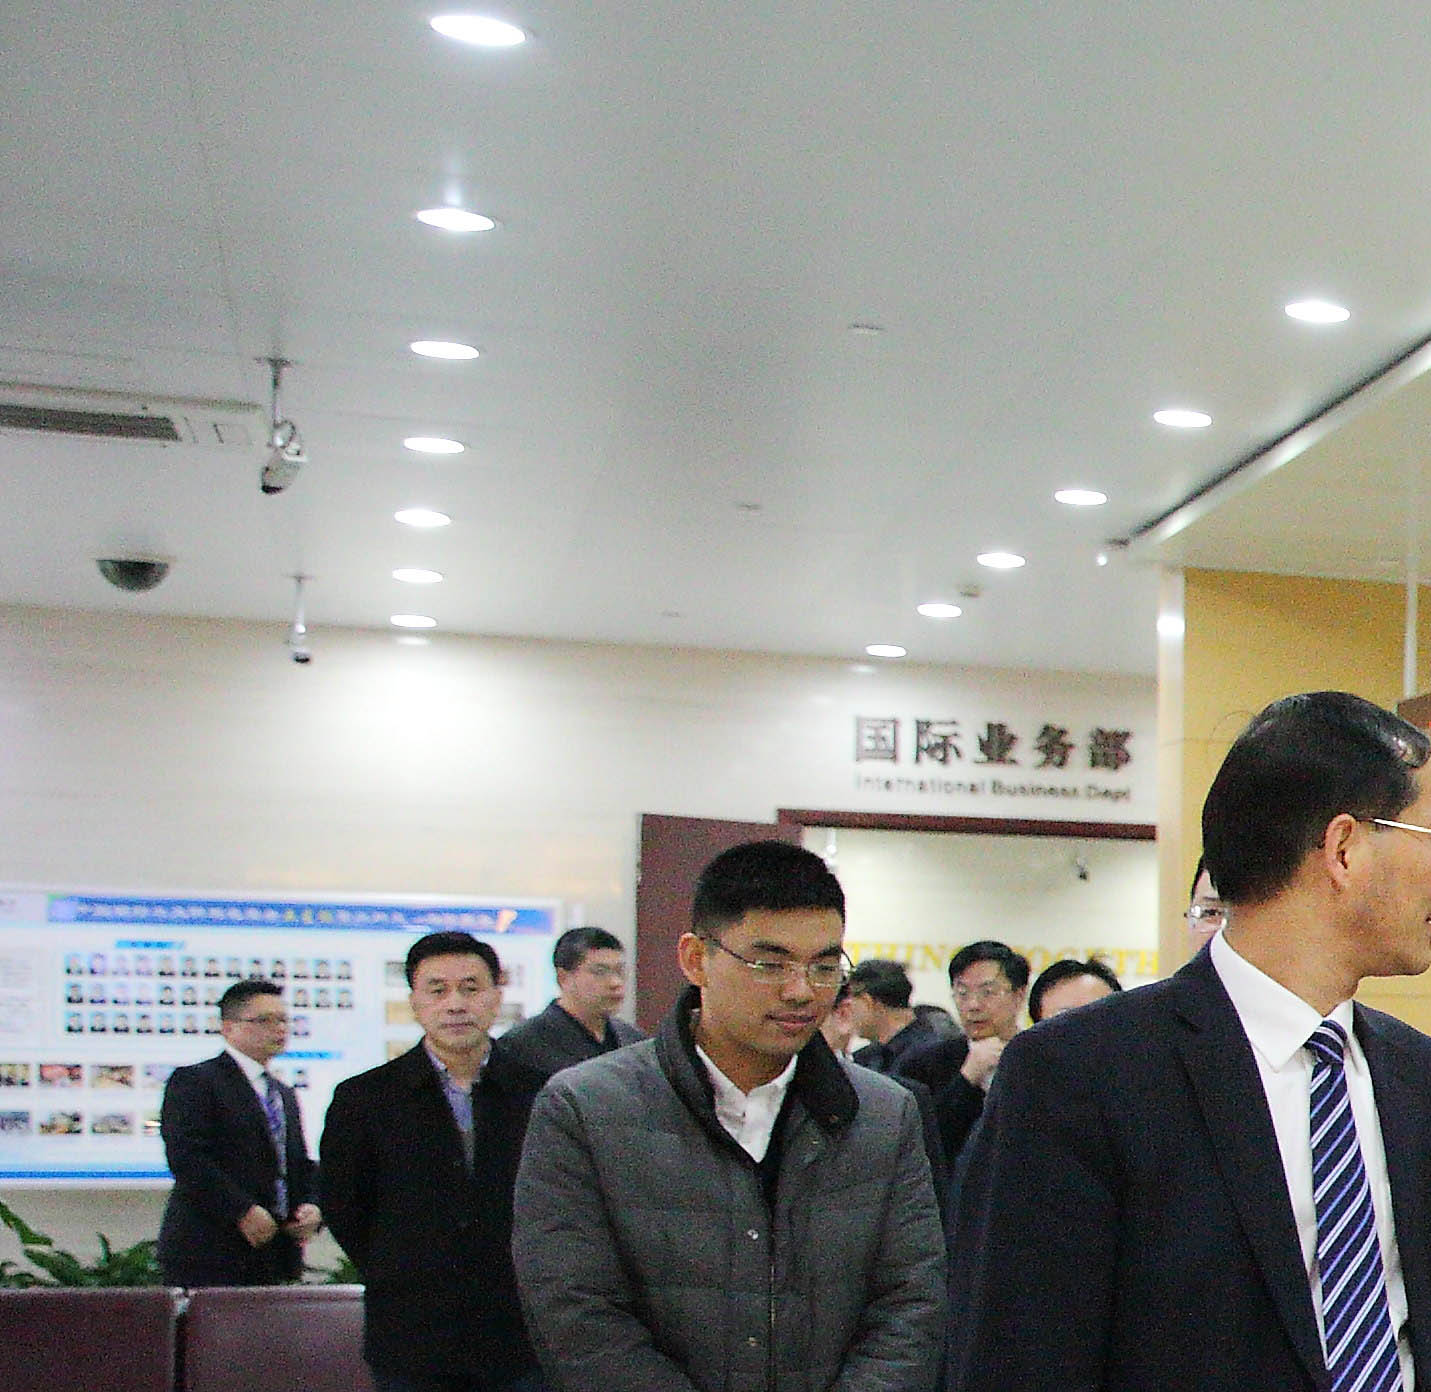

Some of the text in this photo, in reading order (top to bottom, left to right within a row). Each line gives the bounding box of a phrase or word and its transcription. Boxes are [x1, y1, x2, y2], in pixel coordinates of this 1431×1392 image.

[855, 717, 1133, 771] 国际业务部
[992, 780, 1079, 798] Business
